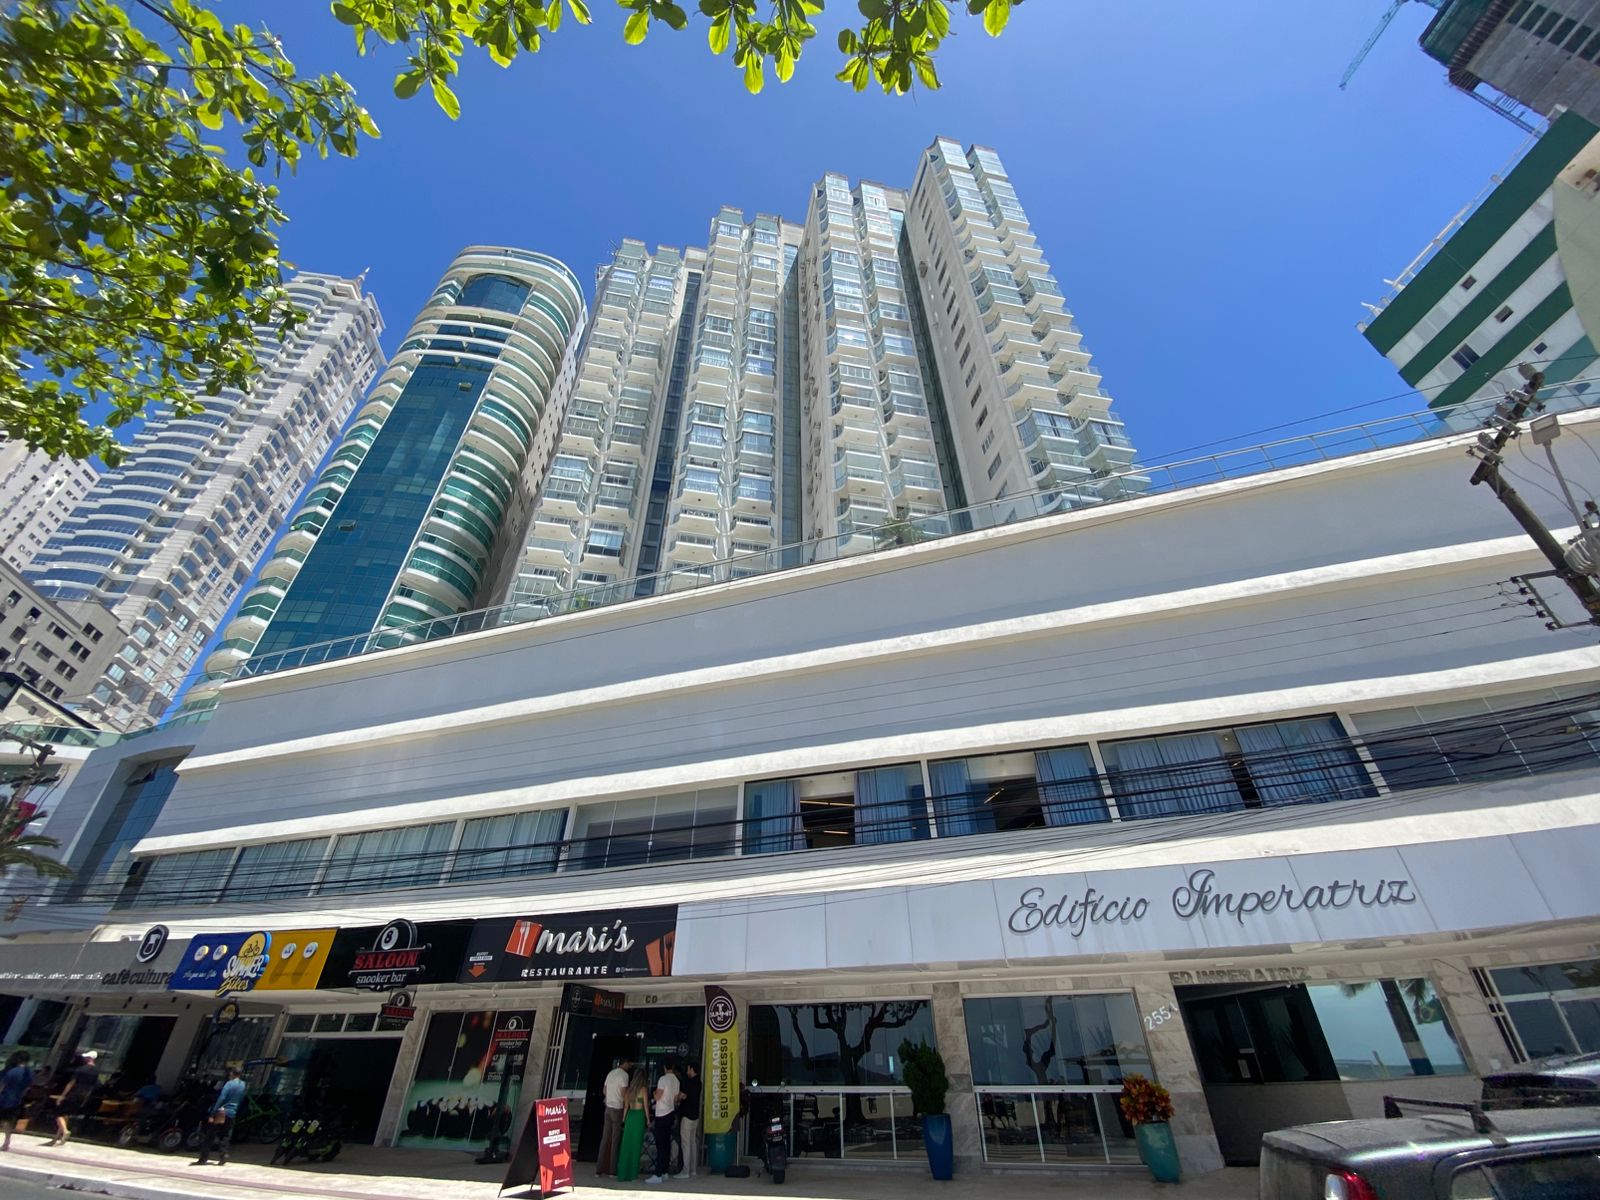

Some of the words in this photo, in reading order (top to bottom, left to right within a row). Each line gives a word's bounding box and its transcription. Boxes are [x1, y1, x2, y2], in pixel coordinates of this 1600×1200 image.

[1008, 887, 1150, 938] Edifício
[1172, 869, 1416, 925] Imperatriz
[536, 920, 635, 955] mari's
[223, 955, 265, 978] SUMMER
[354, 952, 418, 970] SALOON
[521, 966, 608, 977] RESTAURANTE
[356, 973, 390, 984] snooker
[391, 971, 406, 982] bar
[712, 1038, 720, 1066] AQUI
[720, 1038, 728, 1091] INGRESSO
[712, 1069, 720, 1120] COMPRE
[545, 1103, 567, 1116] mari's
[720, 1096, 729, 1119] SEU
